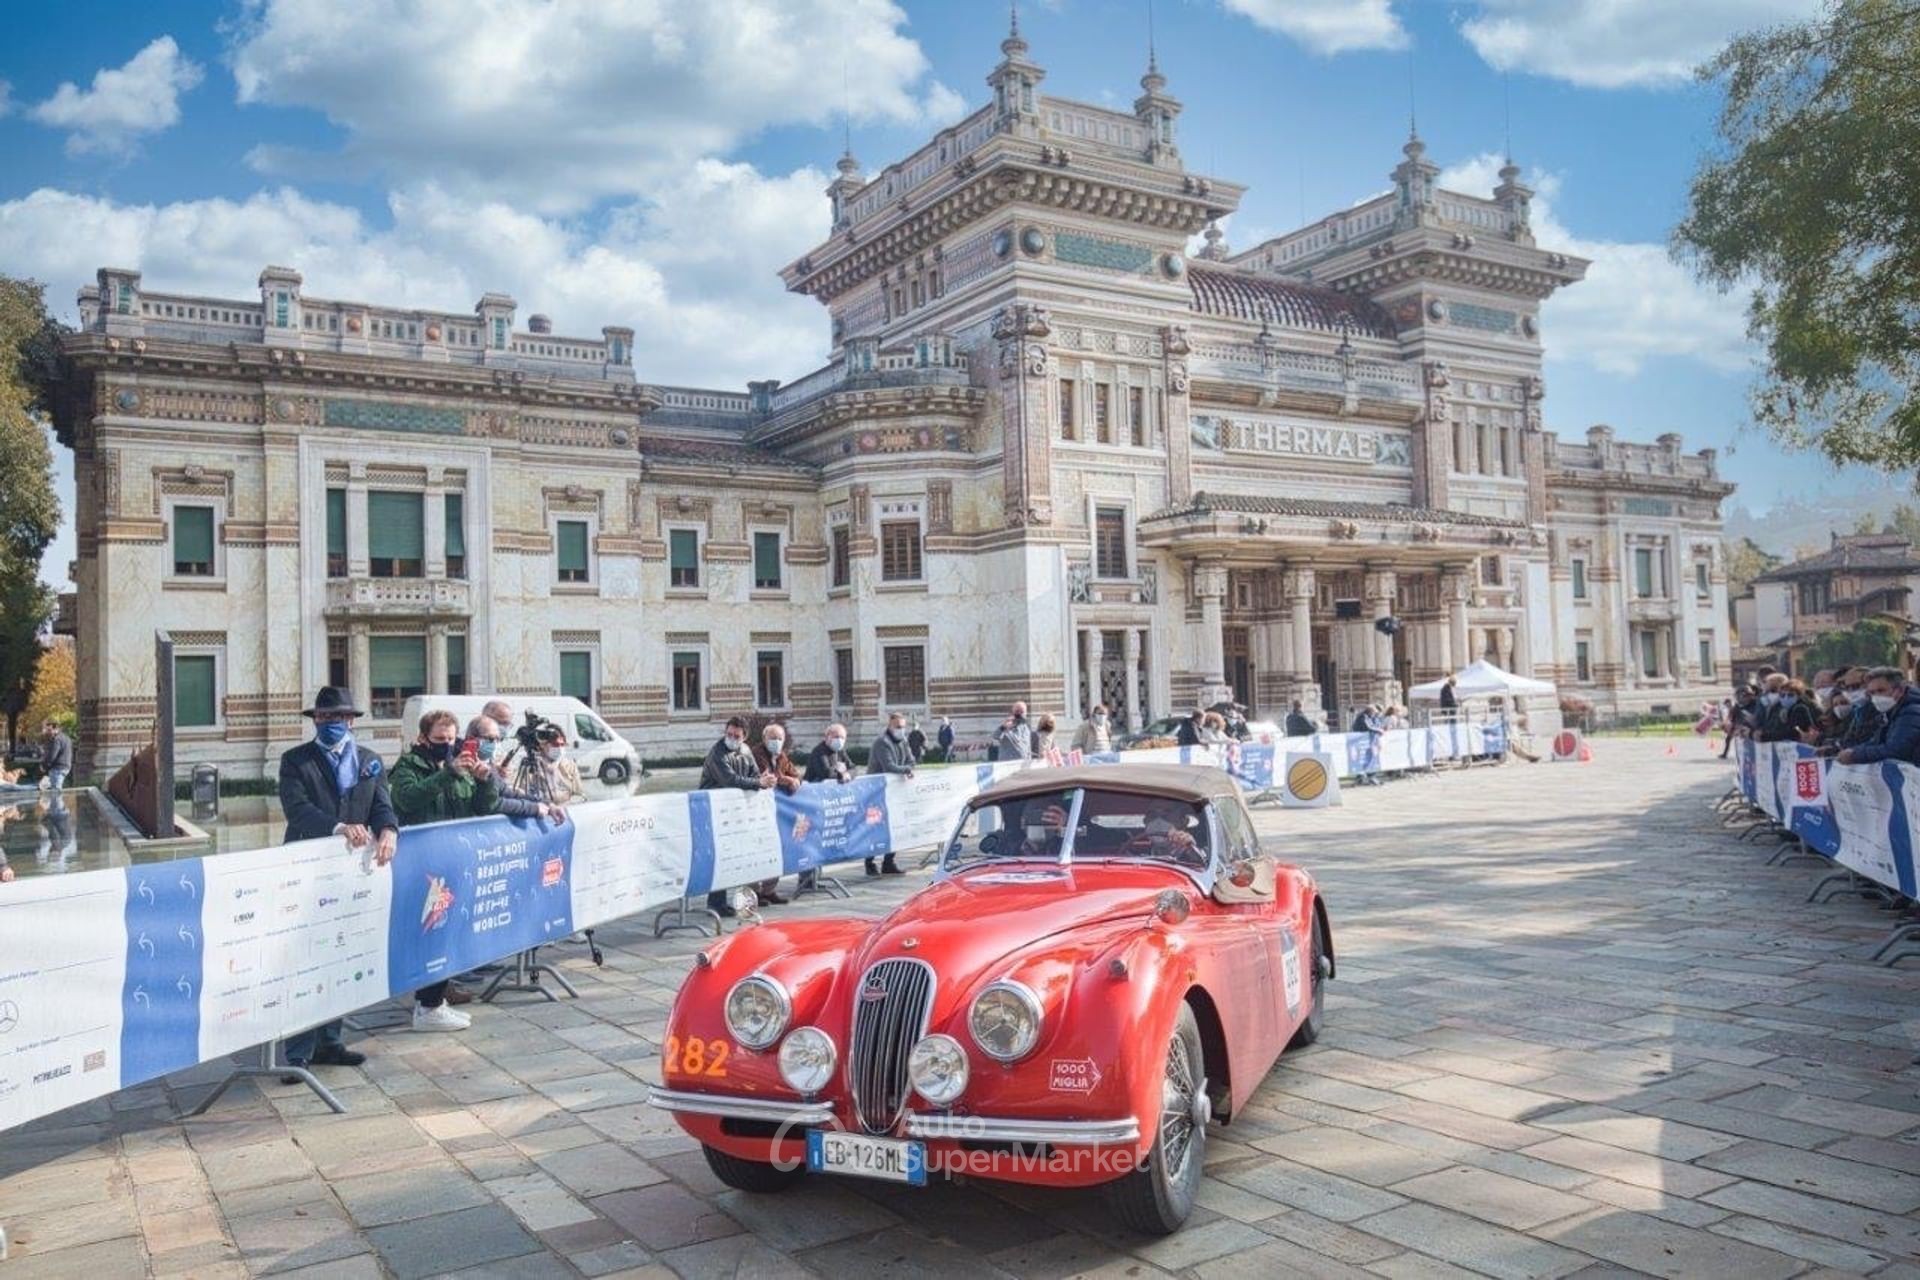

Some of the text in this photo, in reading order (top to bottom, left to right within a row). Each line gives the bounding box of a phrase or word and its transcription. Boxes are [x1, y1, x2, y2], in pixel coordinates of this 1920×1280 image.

[1233, 421, 1373, 458] THERMAE
[608, 816, 655, 835] CHOPARD
[476, 841, 528, 861] THE MOST
[475, 879, 508, 898] RACE
[472, 912, 512, 933] WORLD
[663, 1035, 730, 1077] 282
[1056, 1063, 1086, 1074] 1000
[1052, 1076, 1090, 1089] MIGLIA
